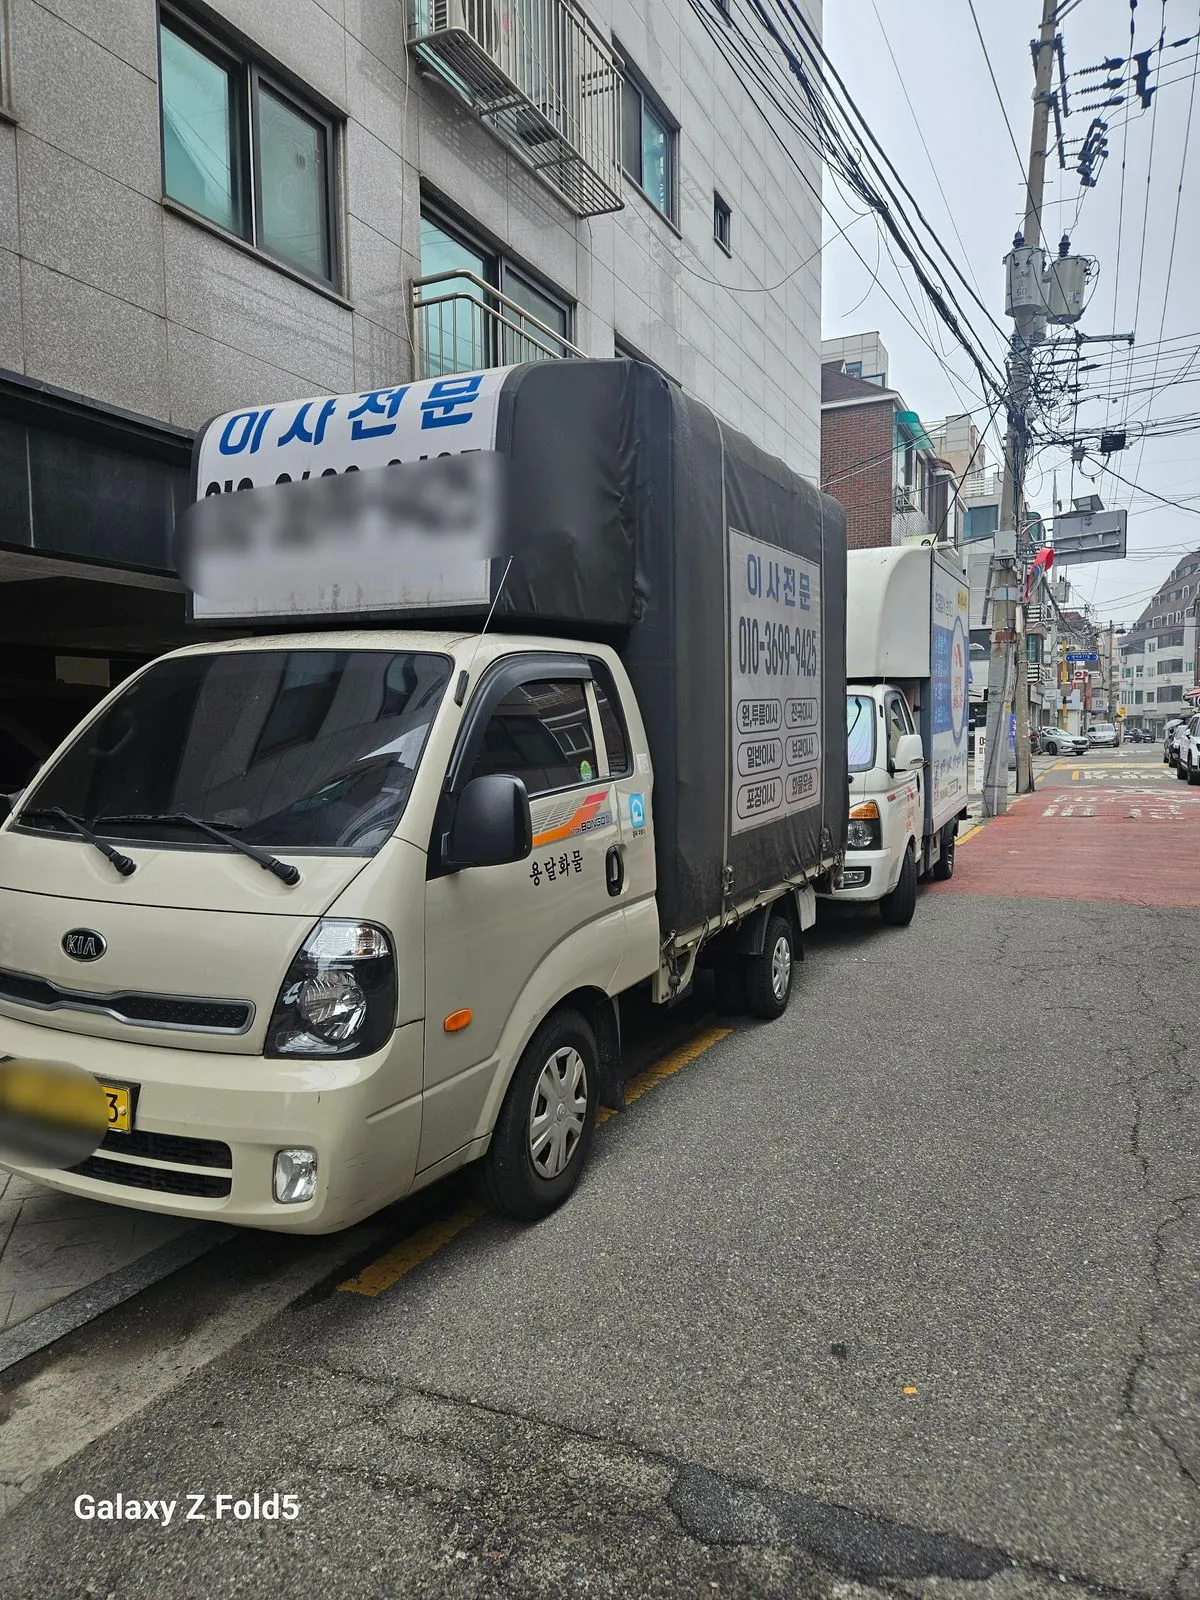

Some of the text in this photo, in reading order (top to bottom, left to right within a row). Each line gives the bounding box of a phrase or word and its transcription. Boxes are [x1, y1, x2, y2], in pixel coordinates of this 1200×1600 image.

[218, 374, 485, 456] 이사전문
[747, 553, 811, 612] 이사전문
[739, 615, 817, 677] 010-3699-9425
[791, 702, 813, 722] 전국이사
[747, 743, 776, 769] 일반이사
[792, 737, 814, 759] 보관이사
[746, 782, 776, 810] 포장이사
[581, 816, 606, 832] BONGO
[529, 850, 583, 886] 용달화물
[66, 934, 97, 956] KIA
